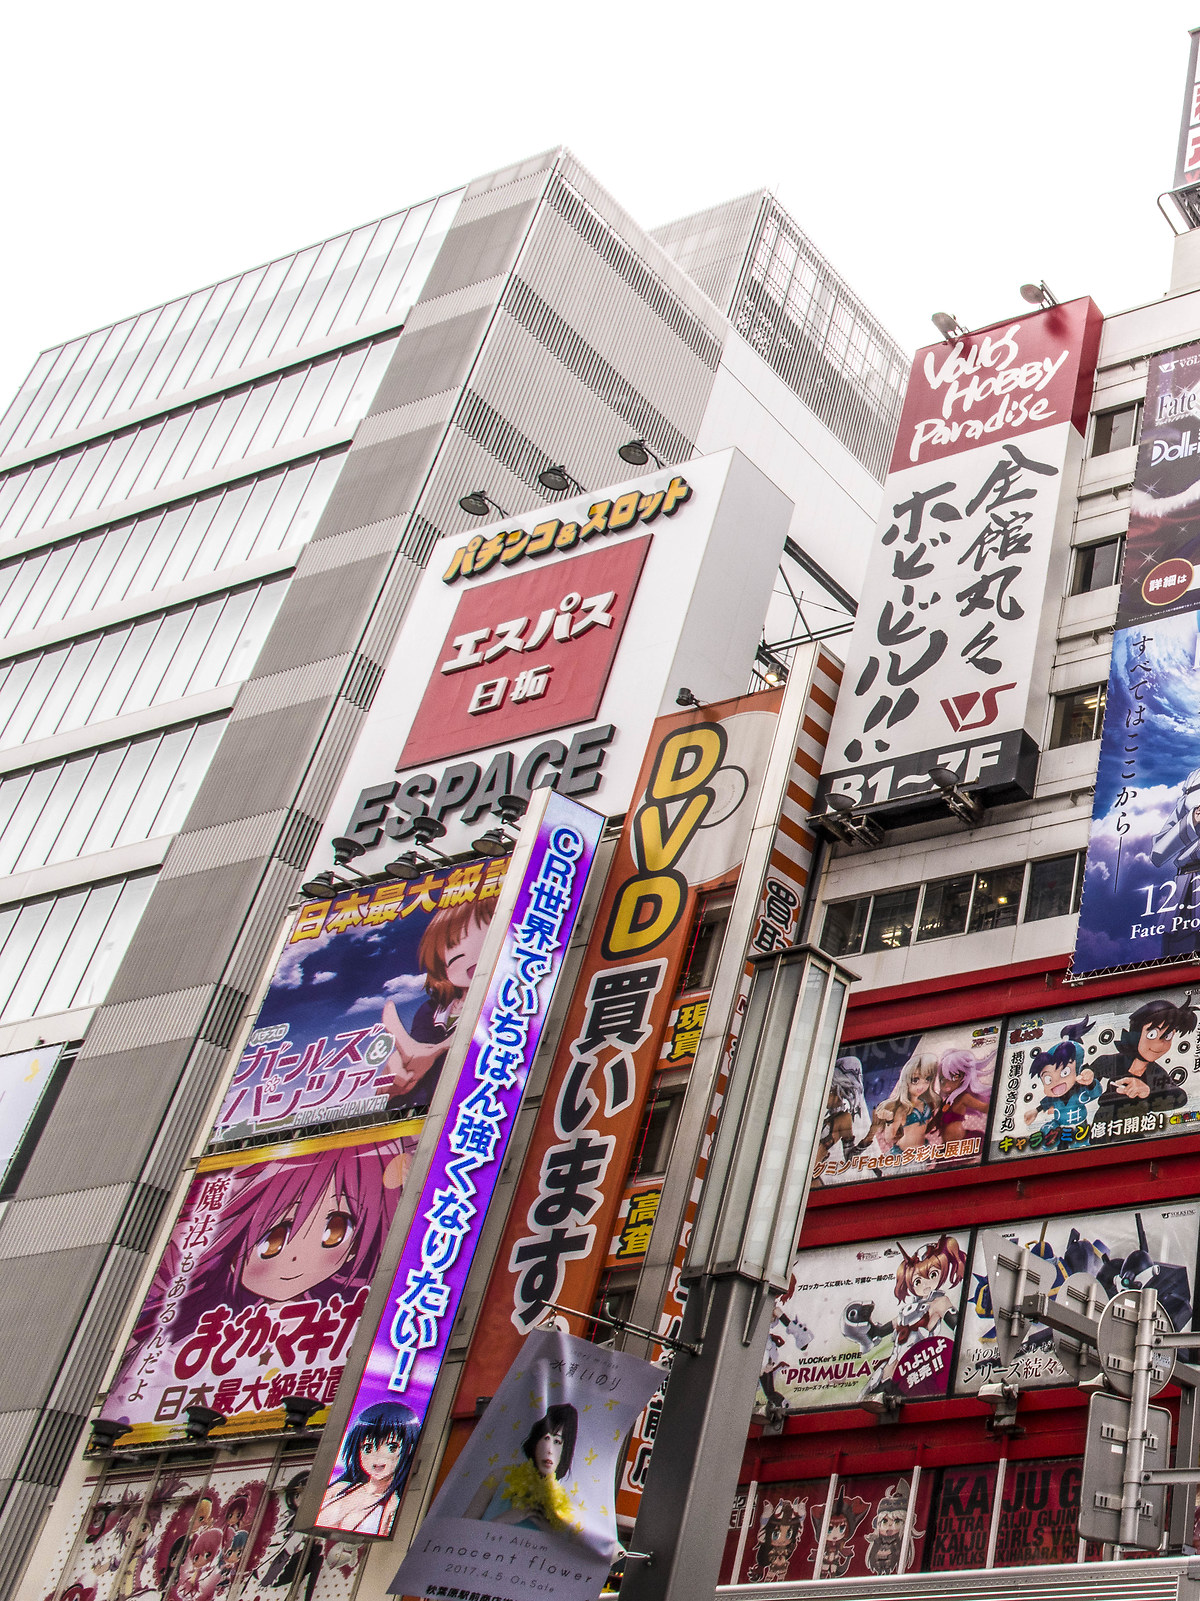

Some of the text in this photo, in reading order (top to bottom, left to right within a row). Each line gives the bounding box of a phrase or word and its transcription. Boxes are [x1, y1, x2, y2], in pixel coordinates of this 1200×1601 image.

[1157, 390, 1197, 421] Fate
[442, 476, 694, 584] パチンコ&スロット
[1148, 573, 1188, 592] 詳細は
[440, 590, 617, 676] エスパス
[466, 663, 554, 716] 日拓
[343, 723, 617, 850] ESPACE
[1129, 922, 1166, 940] Fate
[251, 1025, 289, 1045] パチスロ
[127, 1177, 232, 1403] 魔法もあるんだよ
[798, 1351, 863, 1365] VLOCKer's FIORE
[898, 1337, 948, 1377] いよいよ
[937, 1516, 984, 1534] ULTRA
[510, 1536, 548, 1552] Album
[934, 1532, 988, 1554] KAIJU
[422, 1539, 593, 1584] Innocent flower
